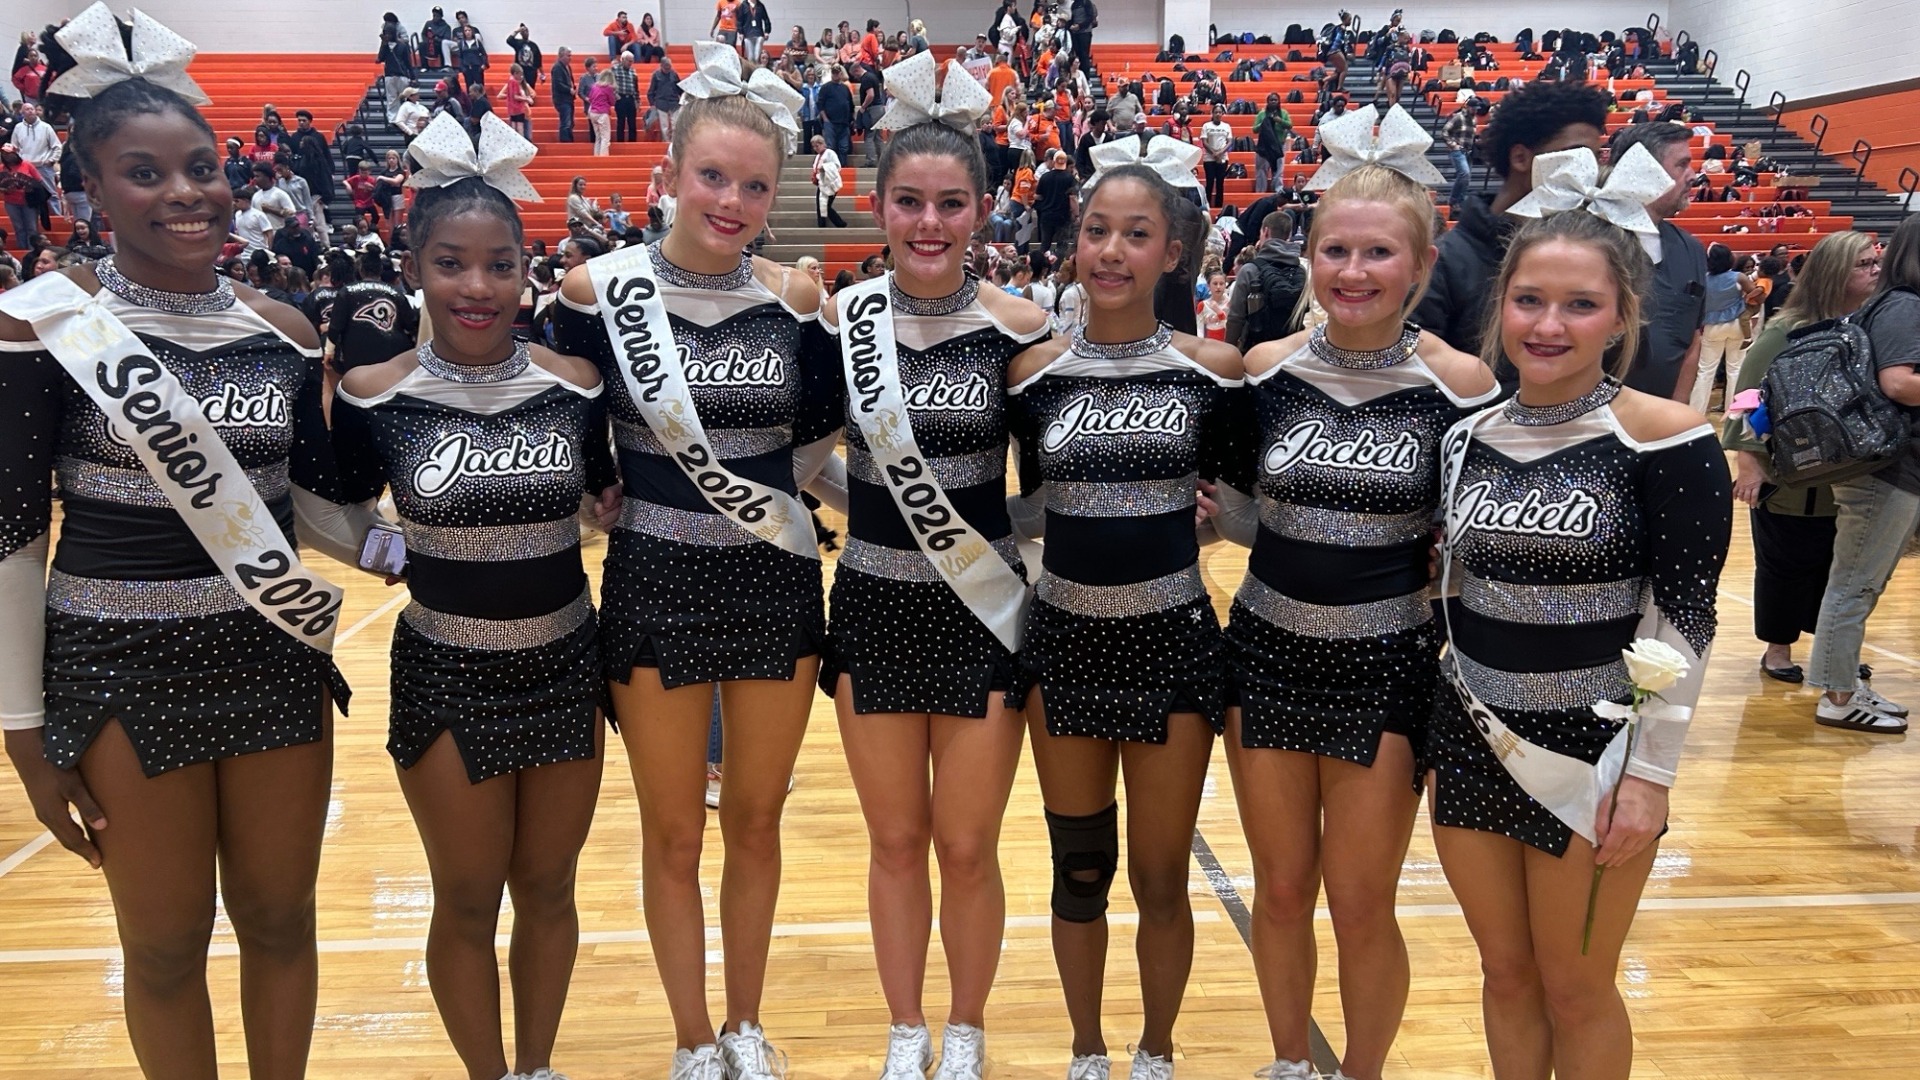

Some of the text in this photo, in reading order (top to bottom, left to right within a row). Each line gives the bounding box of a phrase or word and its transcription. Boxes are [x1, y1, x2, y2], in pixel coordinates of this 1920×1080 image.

[606, 276, 669, 403] Senior
[846, 293, 886, 413] Senior
[96, 354, 223, 510] Senior
[414, 432, 573, 498] Jackets
[1045, 394, 1190, 453] Jackets
[1264, 419, 1422, 475] Jackets
[676, 443, 773, 523] 2026
[886, 456, 967, 551] 2026
[235, 550, 344, 636] 2026
